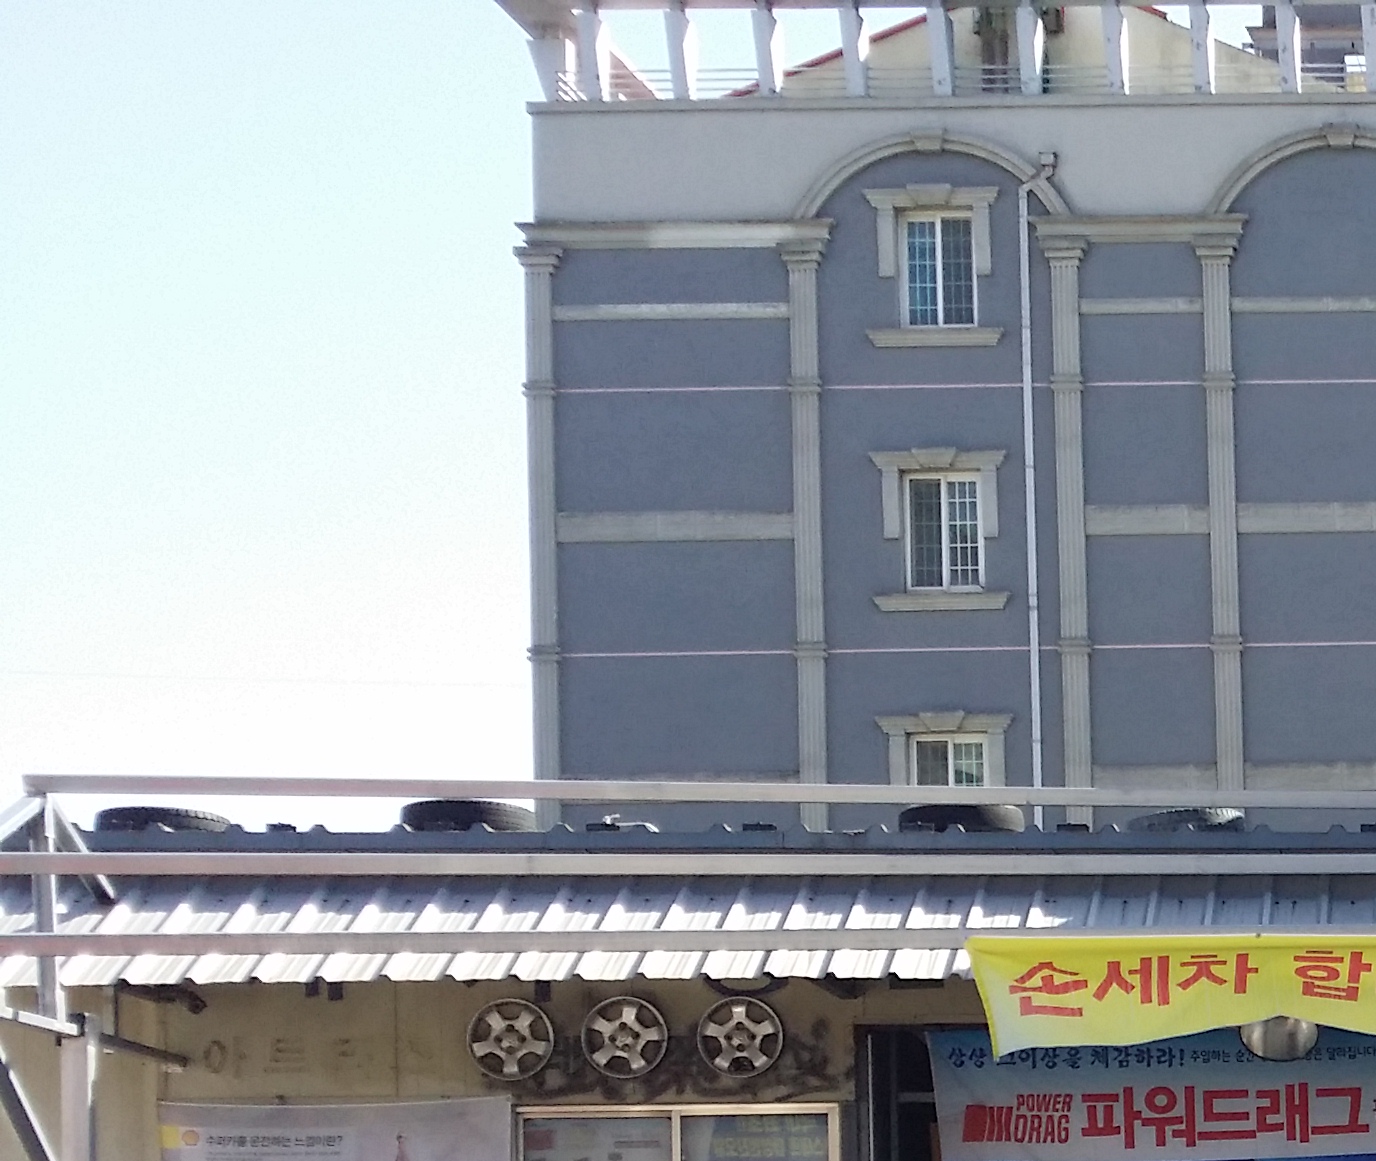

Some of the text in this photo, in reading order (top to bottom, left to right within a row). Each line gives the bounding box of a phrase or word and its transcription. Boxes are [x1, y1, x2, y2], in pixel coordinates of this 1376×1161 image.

[1008, 952, 1259, 1018] 손세차
[948, 1046, 987, 1069] 상상
[1016, 1093, 1073, 1113] POWER
[1081, 1082, 1370, 1149] 파워드래그
[1013, 1113, 1070, 1144] DRAG
